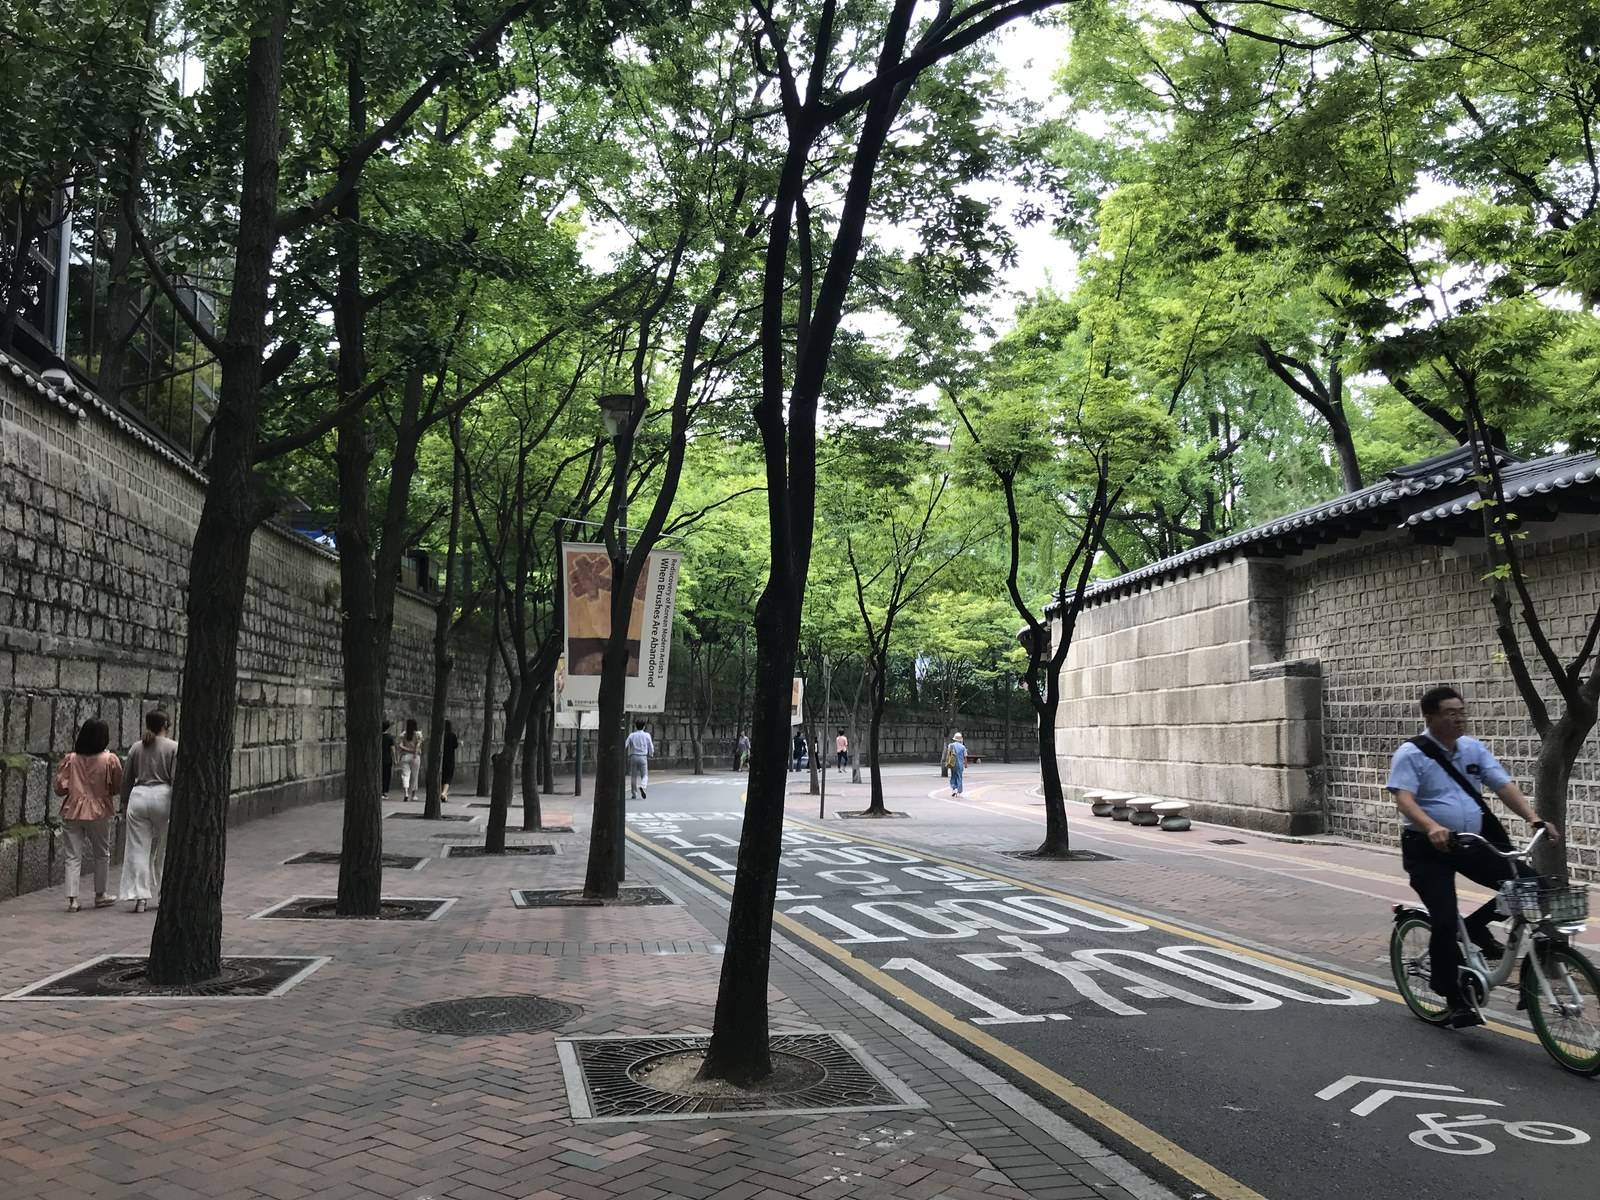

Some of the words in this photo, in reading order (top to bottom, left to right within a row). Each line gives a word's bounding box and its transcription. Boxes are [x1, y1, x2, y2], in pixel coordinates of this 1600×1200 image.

[658, 558, 669, 582] When
[665, 559, 677, 596] Rediscovery
[653, 584, 665, 619] Brushes
[662, 605, 671, 627] Korean
[651, 620, 660, 635] Are
[659, 628, 668, 652] Modern
[647, 637, 659, 687] Abandoned
[657, 653, 666, 674] Artists
[784, 896, 1149, 944] 10:00
[880, 945, 1379, 1025] 17:00
